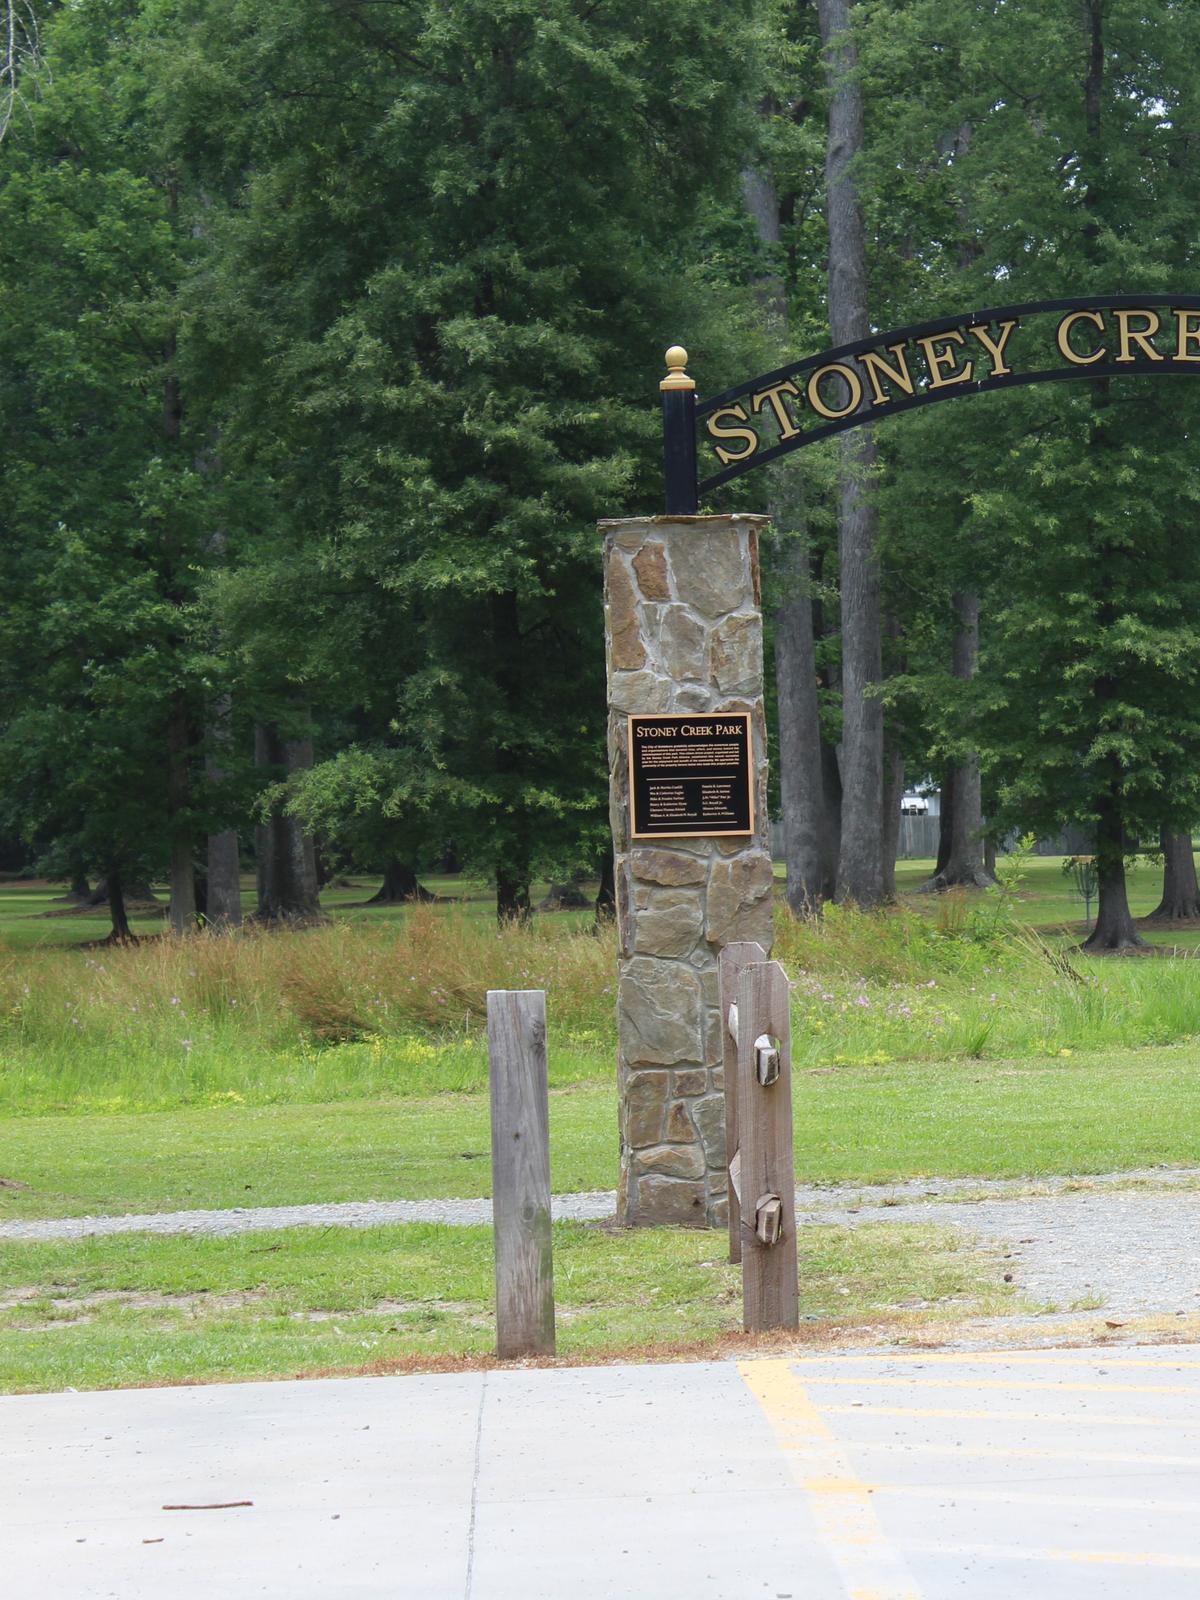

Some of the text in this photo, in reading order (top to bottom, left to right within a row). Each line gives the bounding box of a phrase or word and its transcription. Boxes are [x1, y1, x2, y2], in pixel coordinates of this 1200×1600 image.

[705, 319, 1018, 466] STONEY
[636, 724, 742, 737] STONEY CREEK PARK
